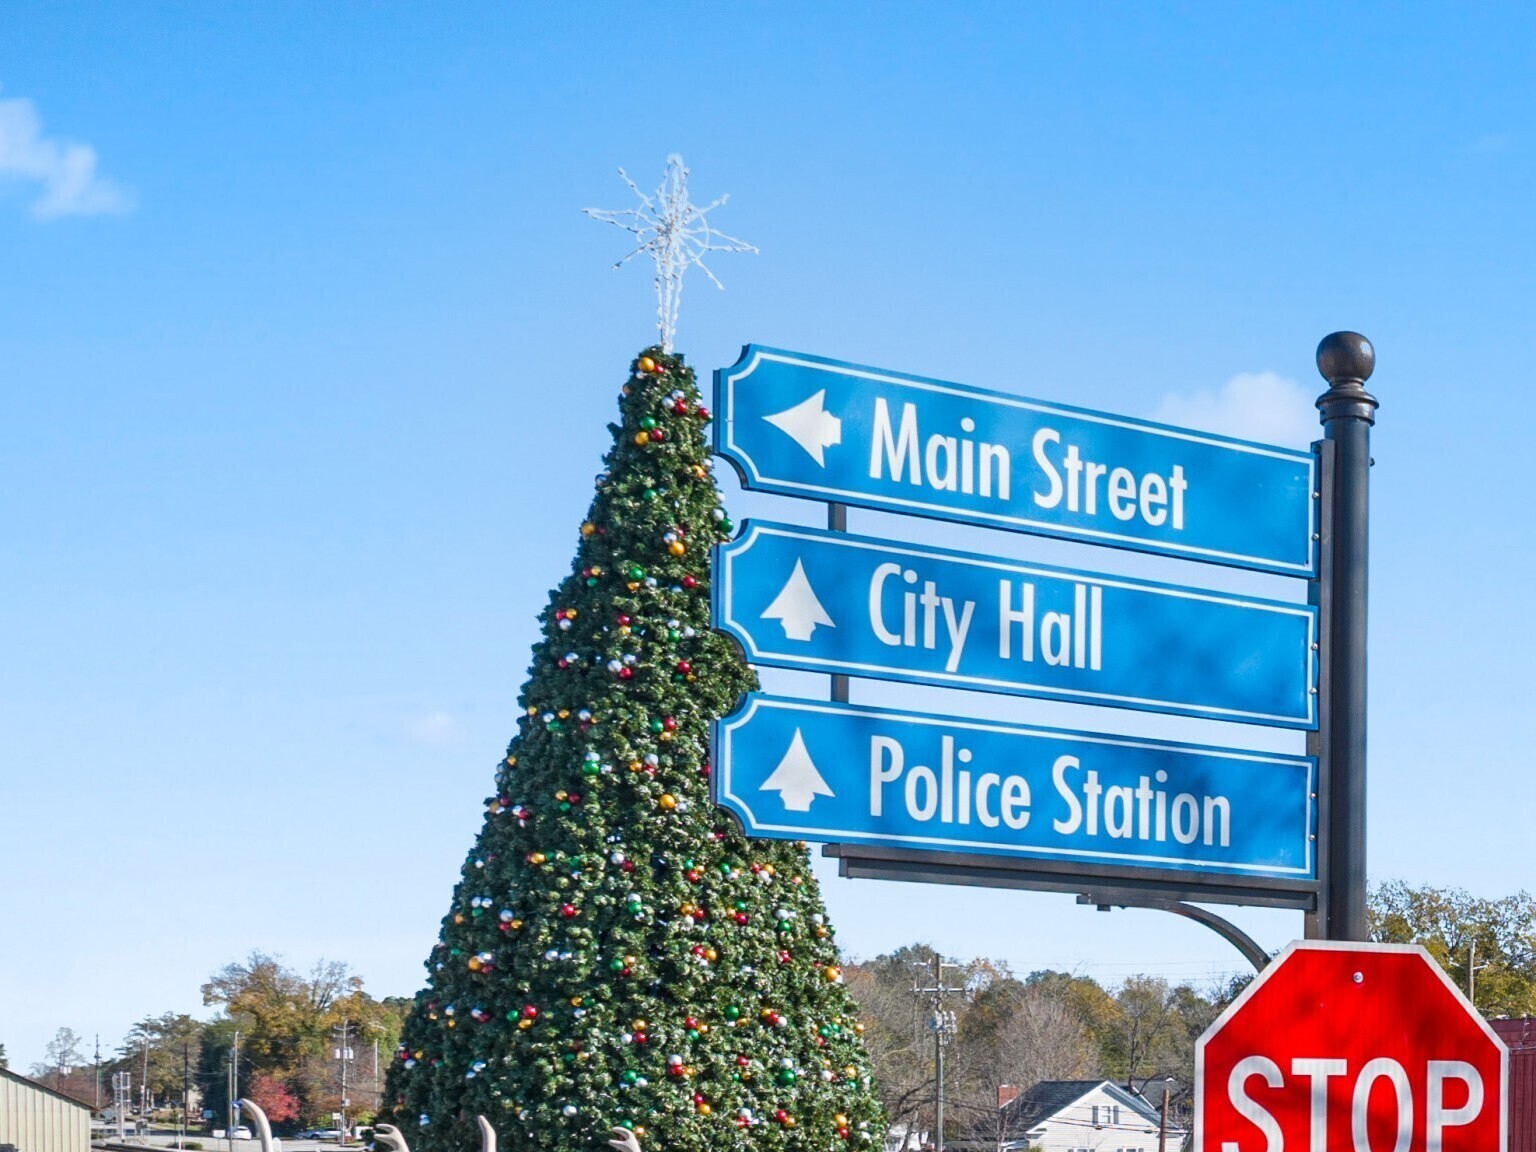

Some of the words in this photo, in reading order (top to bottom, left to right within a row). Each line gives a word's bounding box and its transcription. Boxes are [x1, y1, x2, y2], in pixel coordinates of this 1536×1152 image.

[869, 397, 1010, 502] Main
[1033, 427, 1188, 530] Street
[869, 562, 976, 673] City
[999, 579, 1102, 671] Hall
[869, 735, 1031, 831] Police
[1052, 754, 1230, 848] Station
